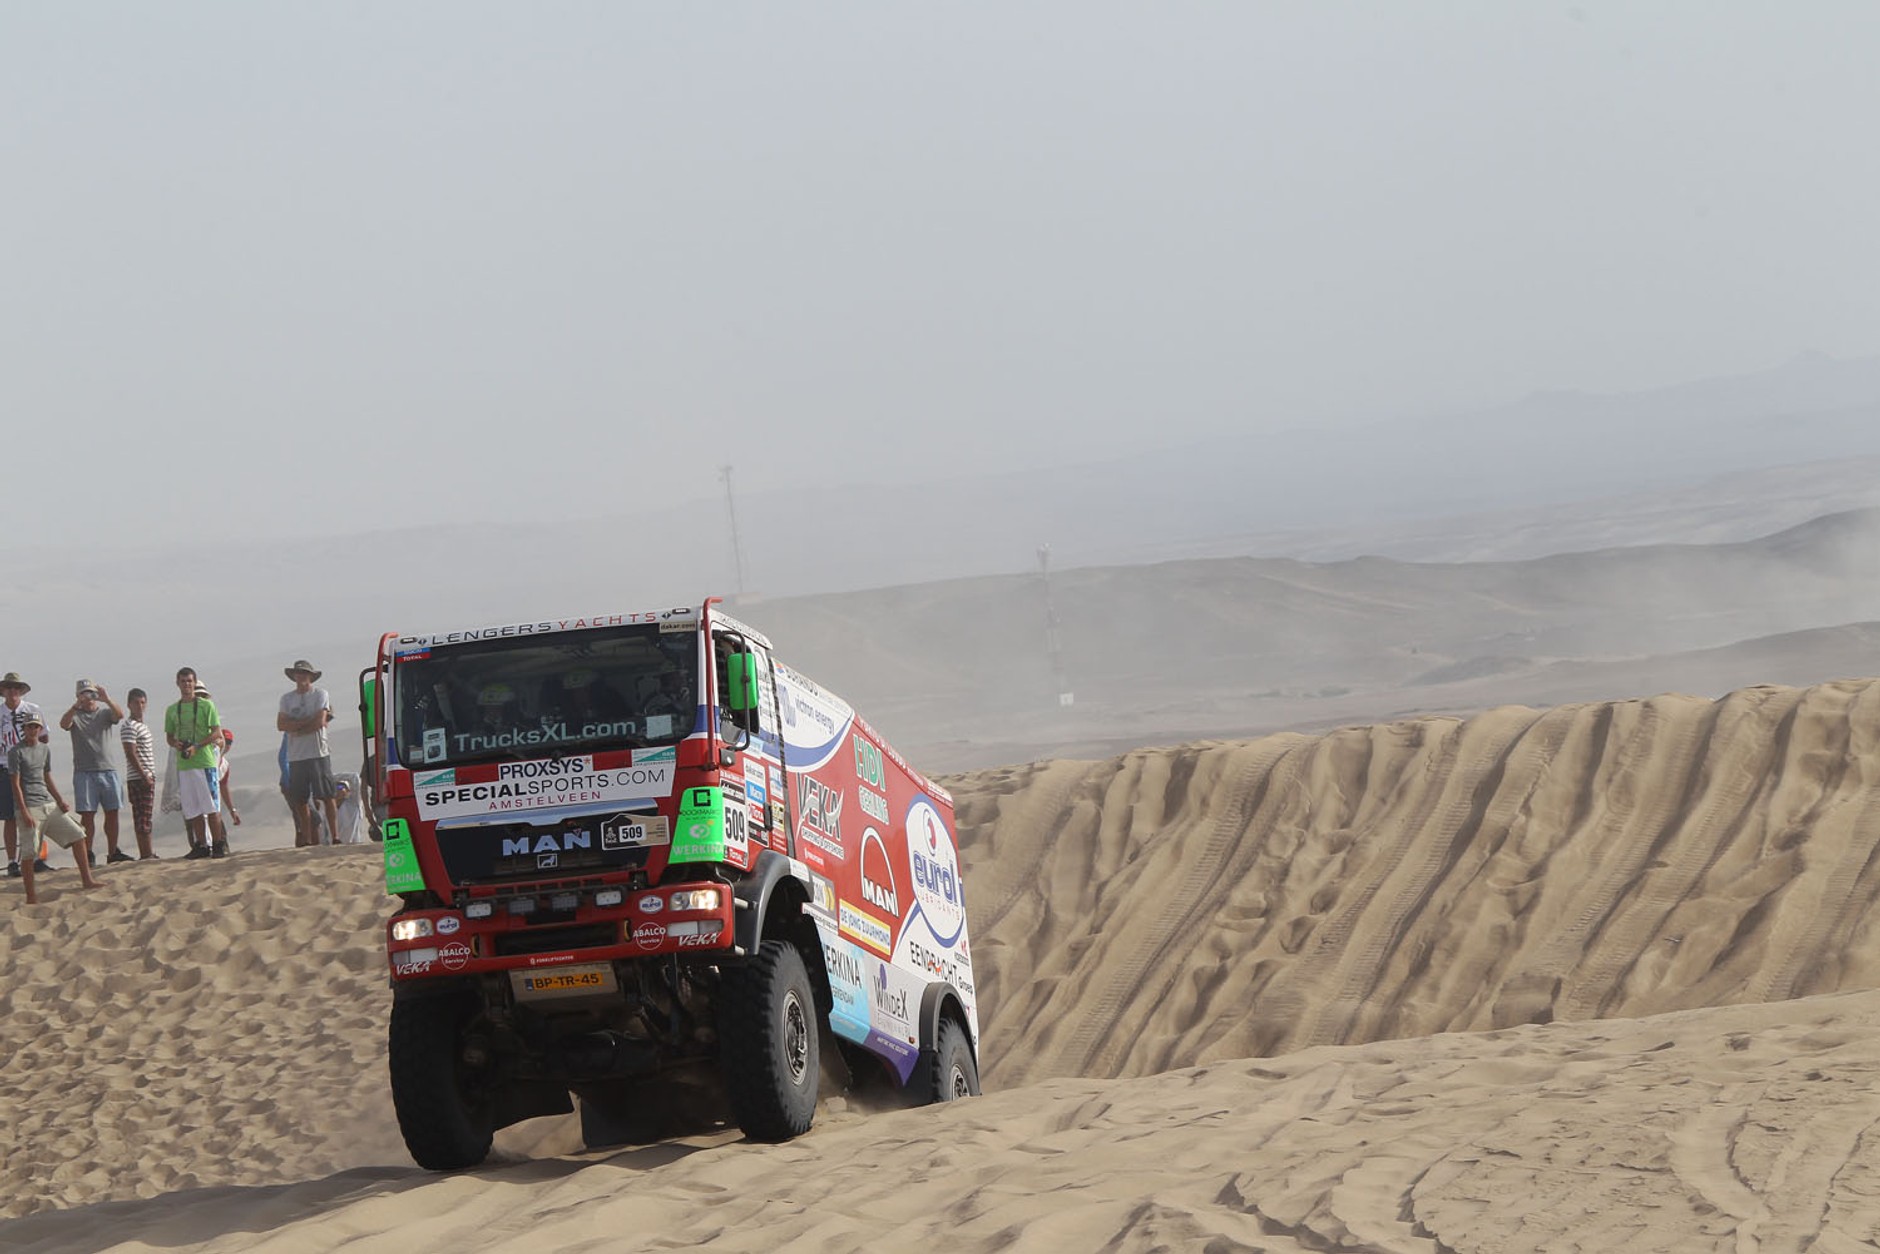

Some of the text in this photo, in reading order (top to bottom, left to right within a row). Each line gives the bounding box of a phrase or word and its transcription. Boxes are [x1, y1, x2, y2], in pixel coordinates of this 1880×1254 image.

[432, 612, 657, 645] LENGERS YACHTS
[454, 721, 636, 752] TrucksXL.com
[853, 734, 886, 792] HDI
[489, 790, 600, 811] AMSTELVEEN
[796, 771, 844, 842] VEKA
[621, 826, 642, 840] 509
[725, 806, 745, 843] 509
[503, 830, 591, 857] MAN
[913, 851, 959, 907] eurol
[863, 875, 899, 918] MAN
[632, 926, 667, 939] ABALCO
[678, 932, 722, 947] VEKA
[438, 946, 471, 957] ABALCO
[910, 941, 958, 988] EENDRACHT
[534, 973, 600, 989] BP-TR-45
